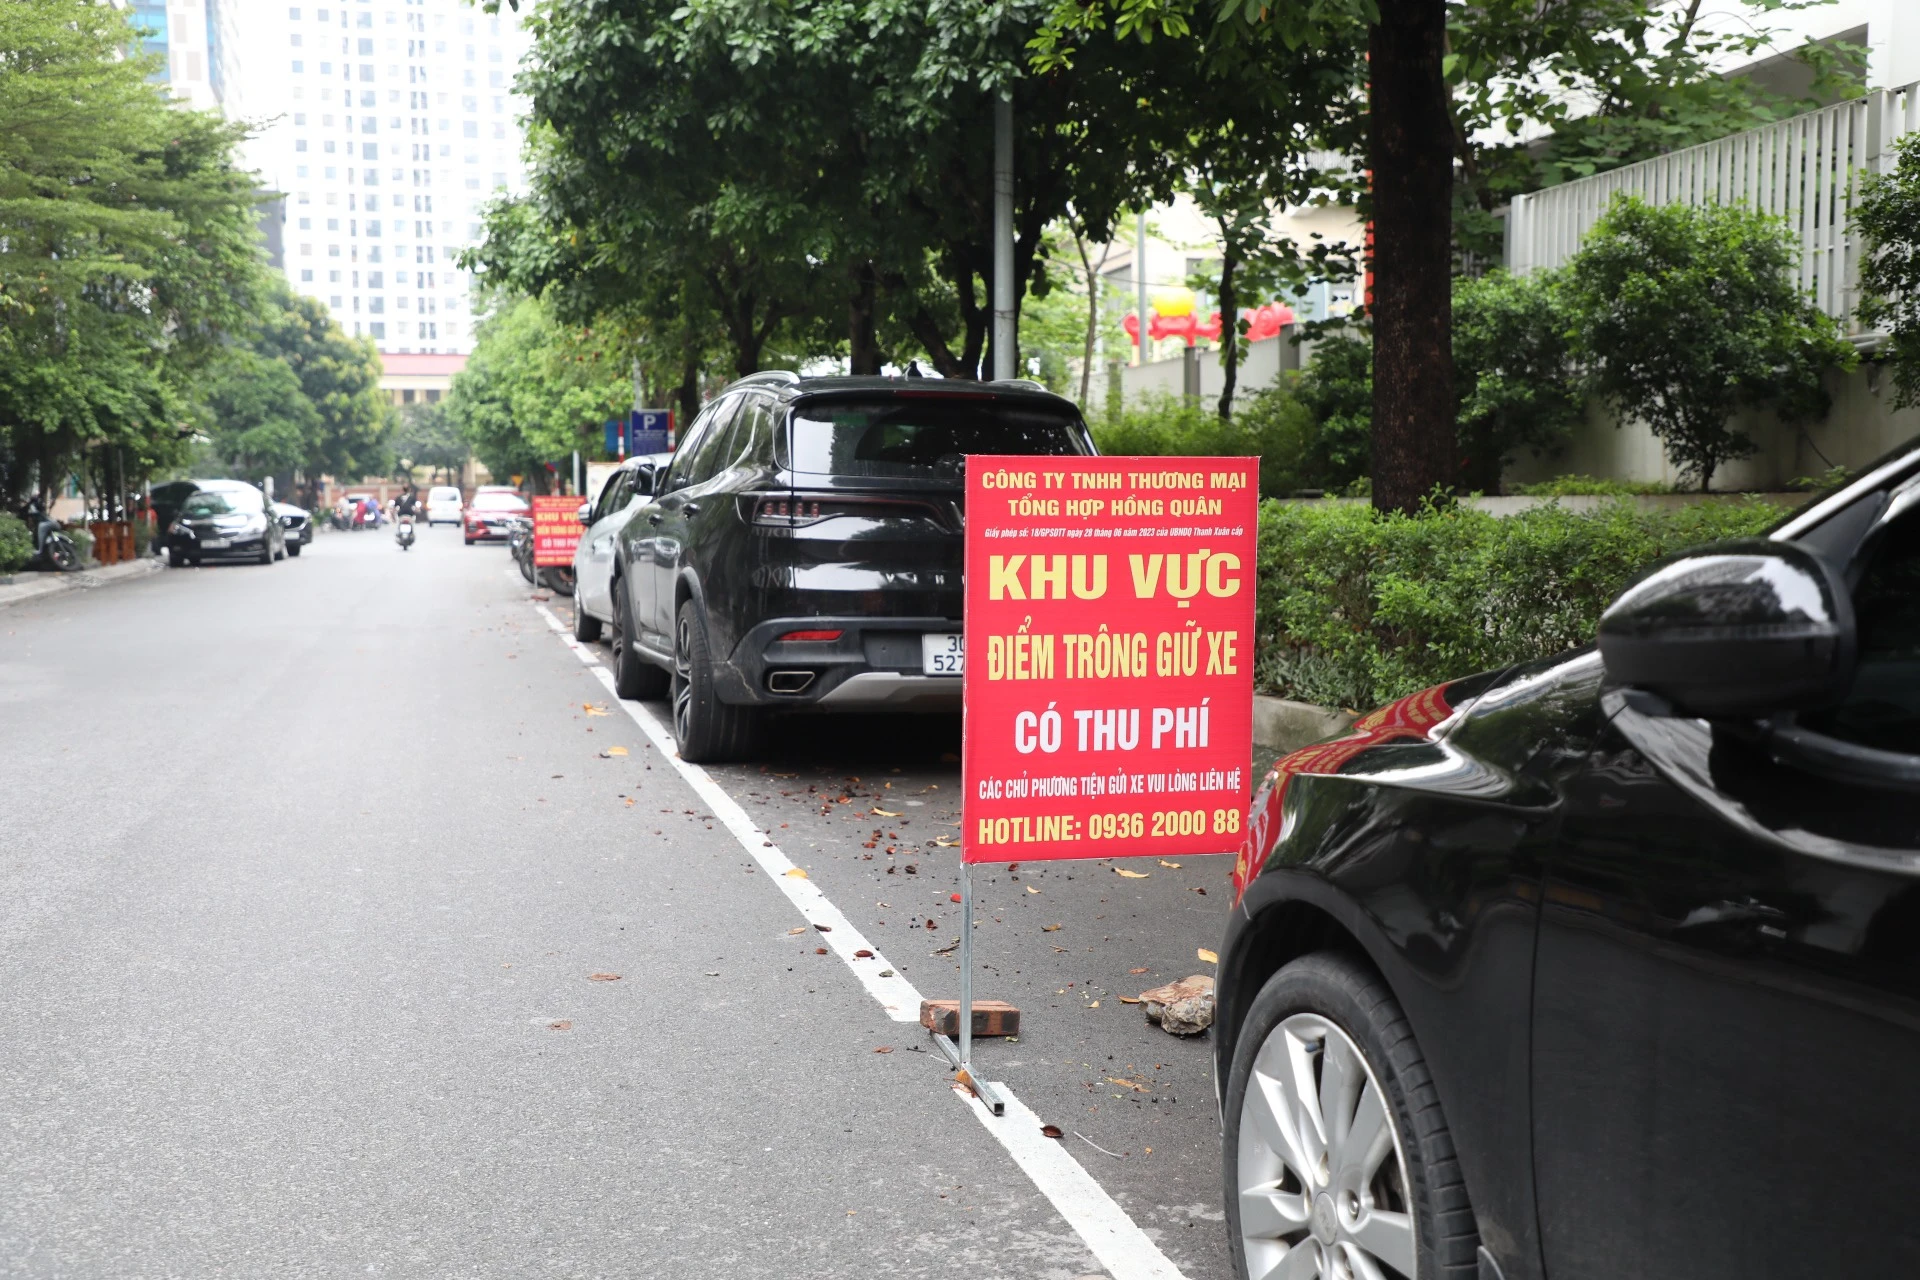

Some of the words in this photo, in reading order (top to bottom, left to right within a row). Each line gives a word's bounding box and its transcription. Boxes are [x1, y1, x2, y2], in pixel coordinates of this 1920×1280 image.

[644, 415, 656, 430] P
[983, 469, 1036, 488] CÔNG
[1043, 473, 1065, 488] TY
[1071, 473, 1121, 489] TNHH
[1128, 472, 1203, 489] THƯƠNG
[1211, 473, 1246, 491] MẠI
[561, 511, 578, 524] VỰ
[1008, 493, 1059, 516] TỔNG
[1066, 499, 1104, 519] HỢP
[1112, 494, 1163, 516] HỒNG
[1170, 496, 1221, 517] QUÂN
[984, 526, 1000, 538] Giấy
[1001, 527, 1018, 538] phép
[1067, 527, 1083, 539] ngày
[1084, 528, 1093, 538] 28
[1094, 527, 1112, 538] tháng
[1113, 527, 1122, 537] 06
[1123, 527, 1138, 537] năm
[1139, 527, 1156, 537] 2023
[1156, 526, 1169, 537] của
[1193, 527, 1213, 537] Thanh
[1213, 526, 1230, 536] Xuân
[1231, 525, 1244, 537] cấp
[990, 555, 1107, 600] KHU
[1129, 549, 1240, 607] VỰC
[988, 615, 1054, 680] ĐIỂM
[1063, 624, 1147, 678] TRÔNG
[1157, 620, 1201, 677] GIỮ
[1206, 631, 1237, 675] XE
[1015, 702, 1061, 753] CÓ
[1074, 709, 1139, 751] THU
[1152, 698, 1210, 748] PHÍ
[979, 776, 1002, 799] CÁC
[1006, 771, 1028, 798] CHỦ
[1032, 776, 1077, 797] PHƯƠNG
[1081, 772, 1105, 799] TIỆN
[1130, 775, 1144, 793] XE
[1148, 774, 1165, 792] VUI
[1169, 769, 1196, 792] LÒNG
[1200, 768, 1223, 790] LIÊN
[1227, 767, 1240, 793] HỆ
[979, 816, 1081, 844] HOTLINE:
[1089, 813, 1143, 839] 0936
[1152, 810, 1205, 836] 2000
[1213, 809, 1239, 834] 88
